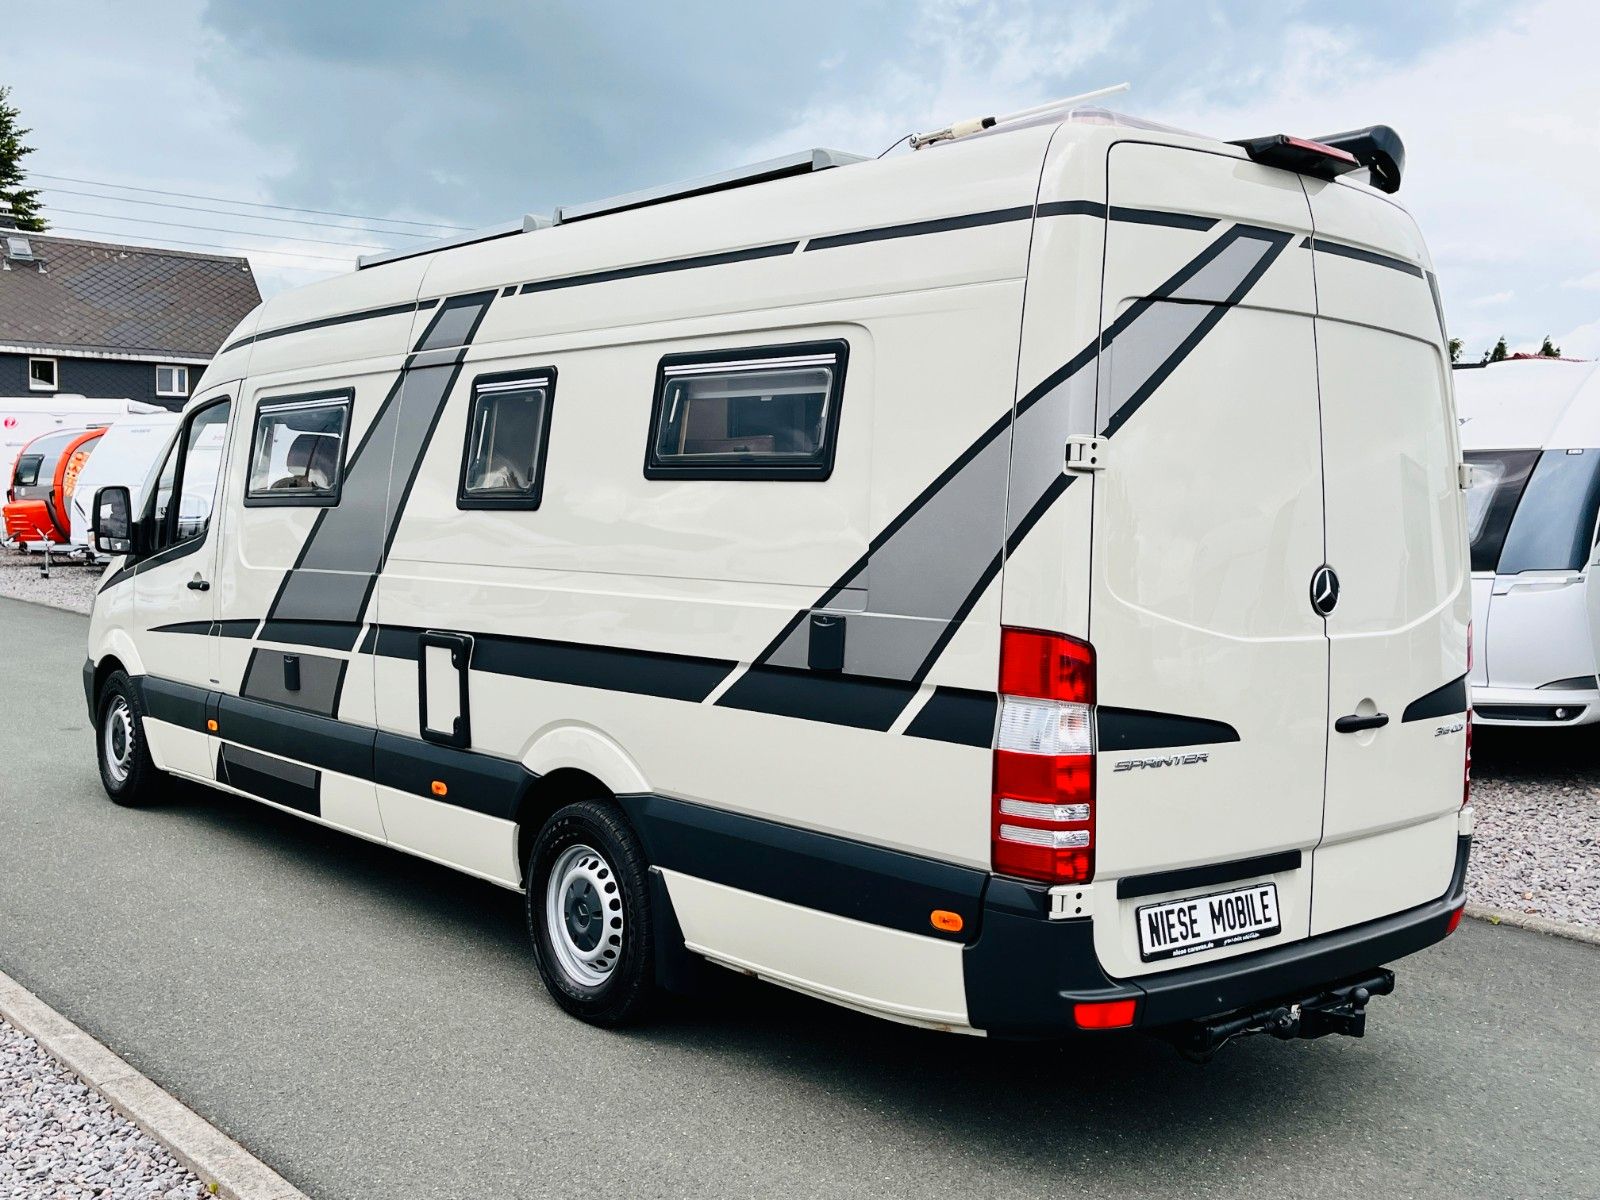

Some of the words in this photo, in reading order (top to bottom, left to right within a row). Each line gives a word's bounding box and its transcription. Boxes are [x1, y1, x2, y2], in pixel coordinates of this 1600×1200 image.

[1113, 753, 1209, 772] SPRINTER
[1147, 904, 1201, 947] NIESE
[1209, 890, 1272, 934] MOBILE
